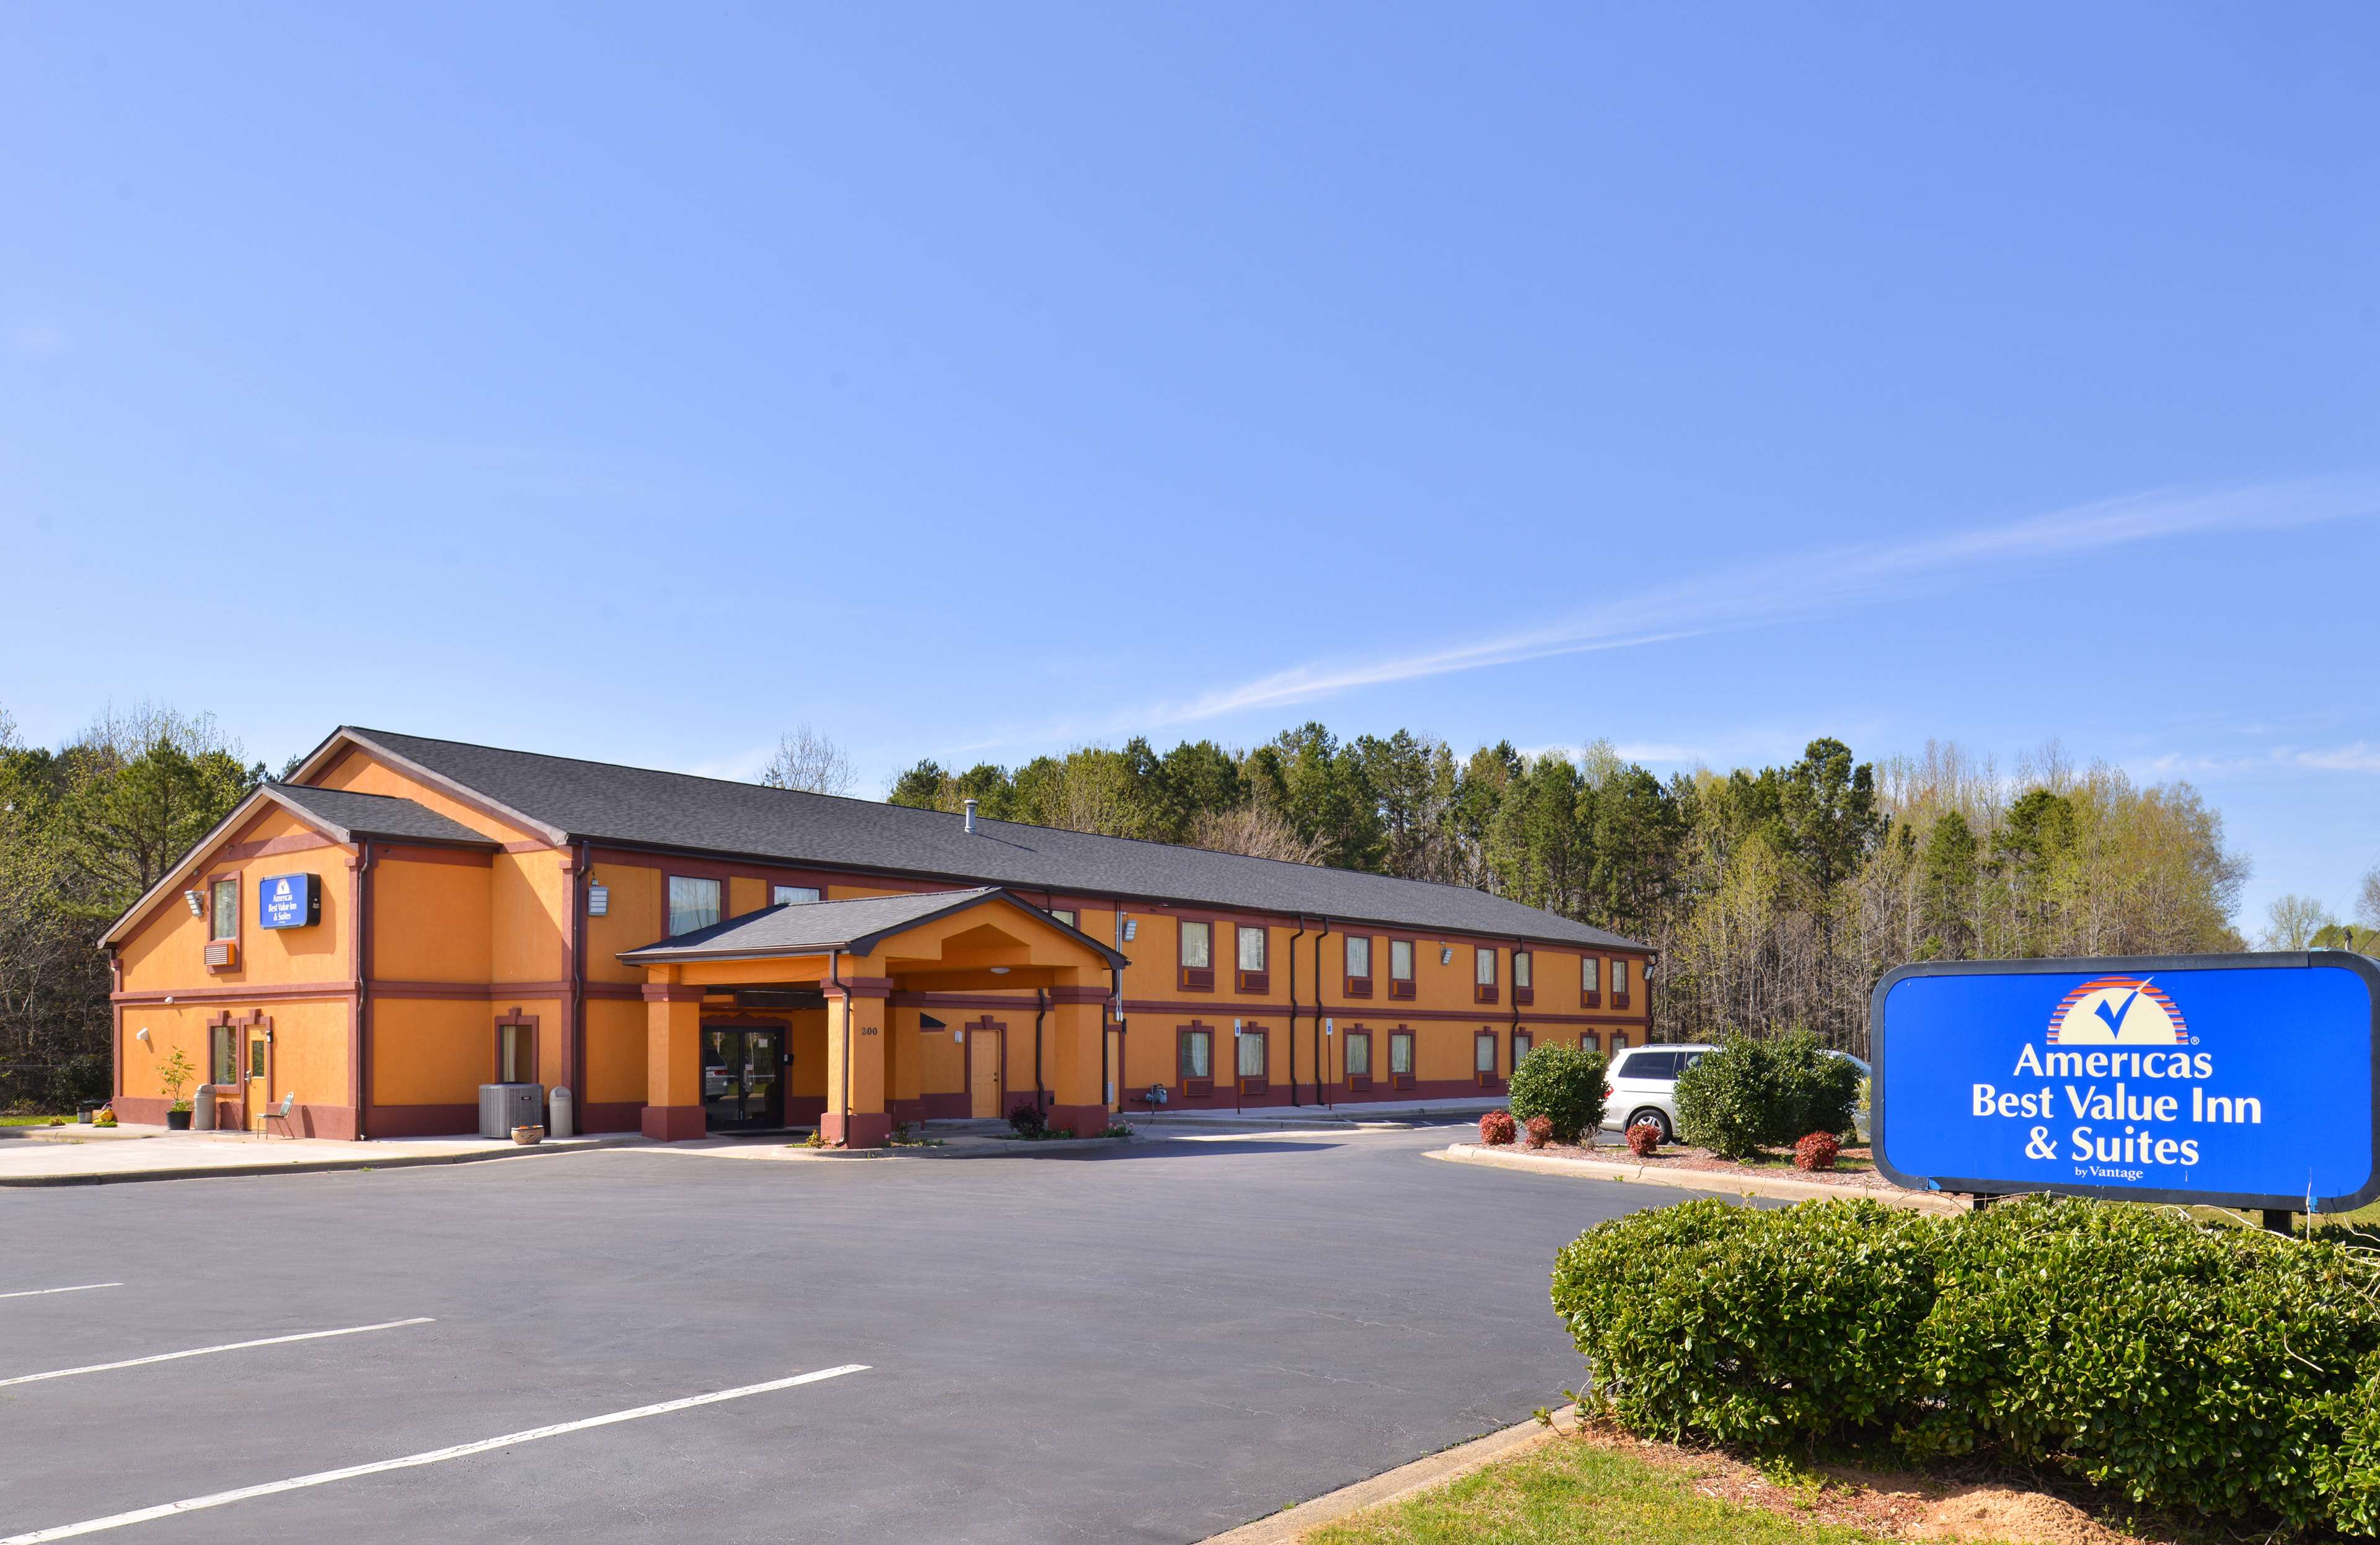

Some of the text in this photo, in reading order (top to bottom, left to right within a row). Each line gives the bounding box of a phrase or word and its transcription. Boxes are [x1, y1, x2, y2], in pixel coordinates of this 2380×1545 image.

[273, 894, 293, 903] Americas
[268, 903, 278, 912] Best
[278, 902, 289, 911] Value
[273, 911, 291, 921] & Suites
[862, 1027, 878, 1035] 200
[2013, 1043, 2213, 1079] Americas
[1973, 1082, 2262, 1124] Best Value Inn
[2025, 1125, 2200, 1166] & Suites
[2074, 1166, 2143, 1181] by Vantage
